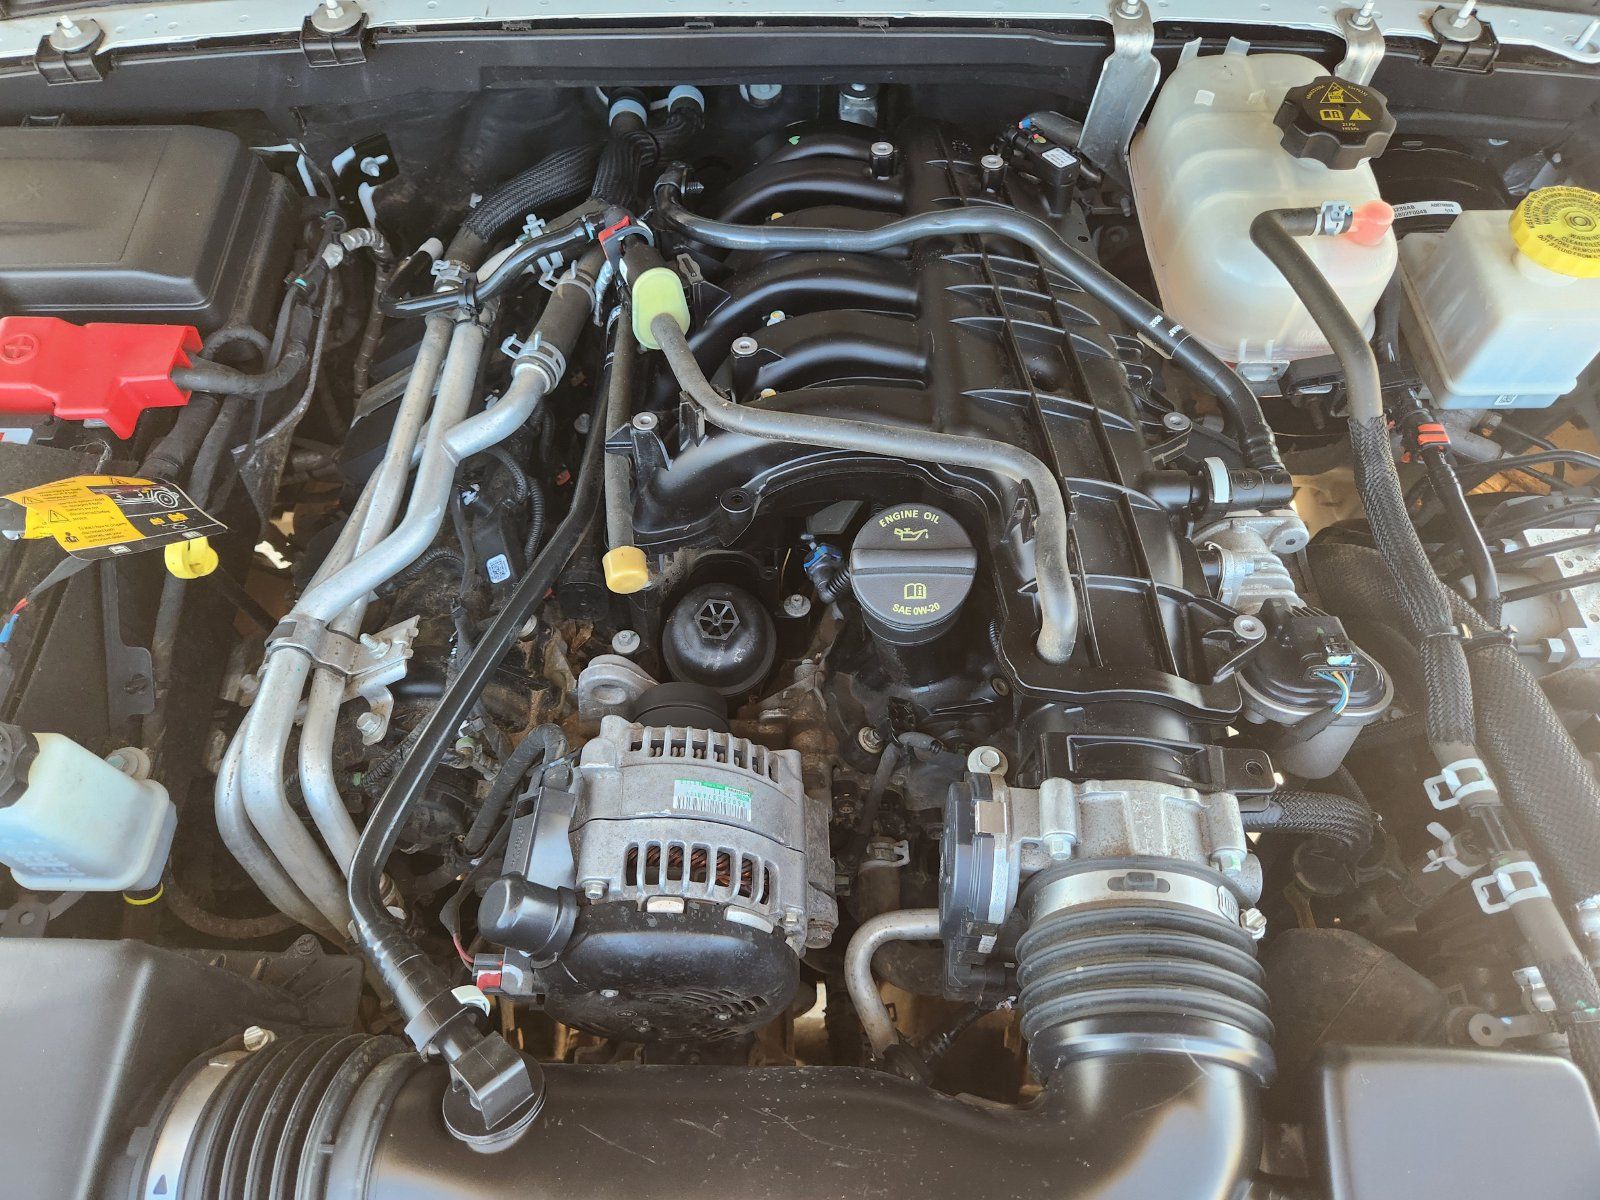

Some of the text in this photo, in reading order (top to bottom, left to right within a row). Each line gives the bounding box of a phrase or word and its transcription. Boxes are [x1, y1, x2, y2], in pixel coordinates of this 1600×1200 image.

[878, 510, 940, 528] ENGINE OIL
[892, 602, 940, 616] SAE 0W-20
